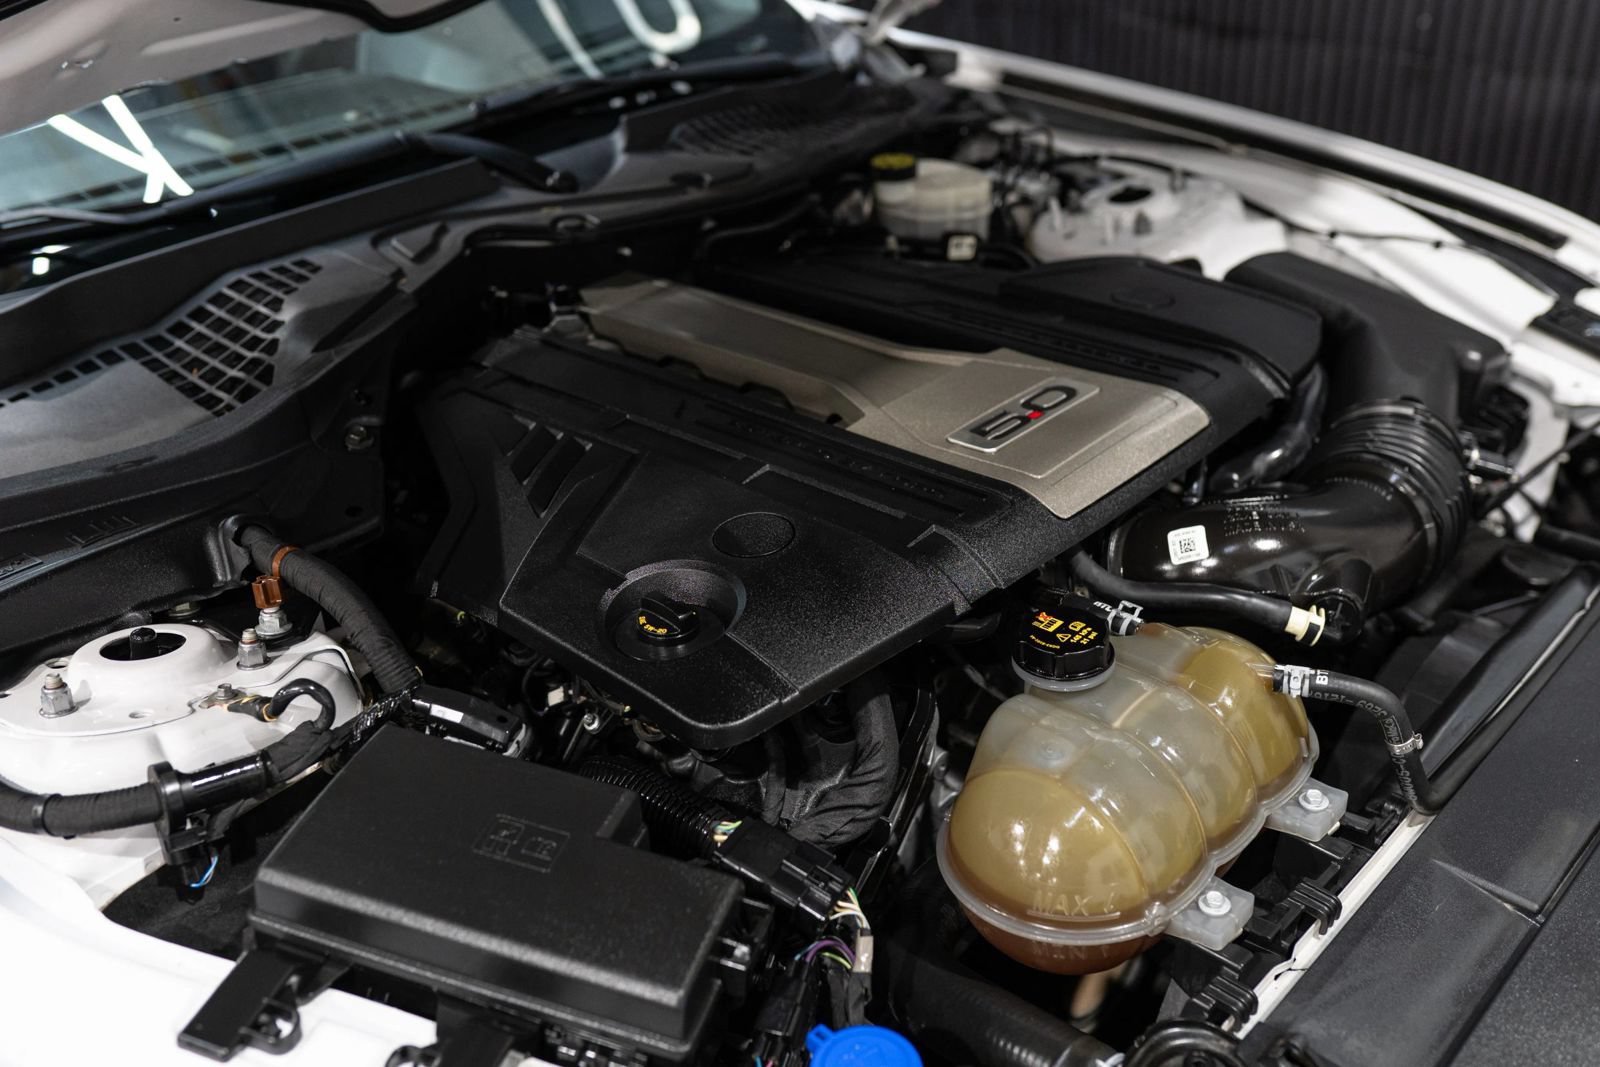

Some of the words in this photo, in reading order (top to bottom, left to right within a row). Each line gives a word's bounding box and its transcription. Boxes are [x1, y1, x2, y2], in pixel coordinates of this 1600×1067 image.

[970, 385, 1077, 441] 5.0
[644, 624, 667, 634] 5W-20
[1032, 888, 1093, 917] MAX
